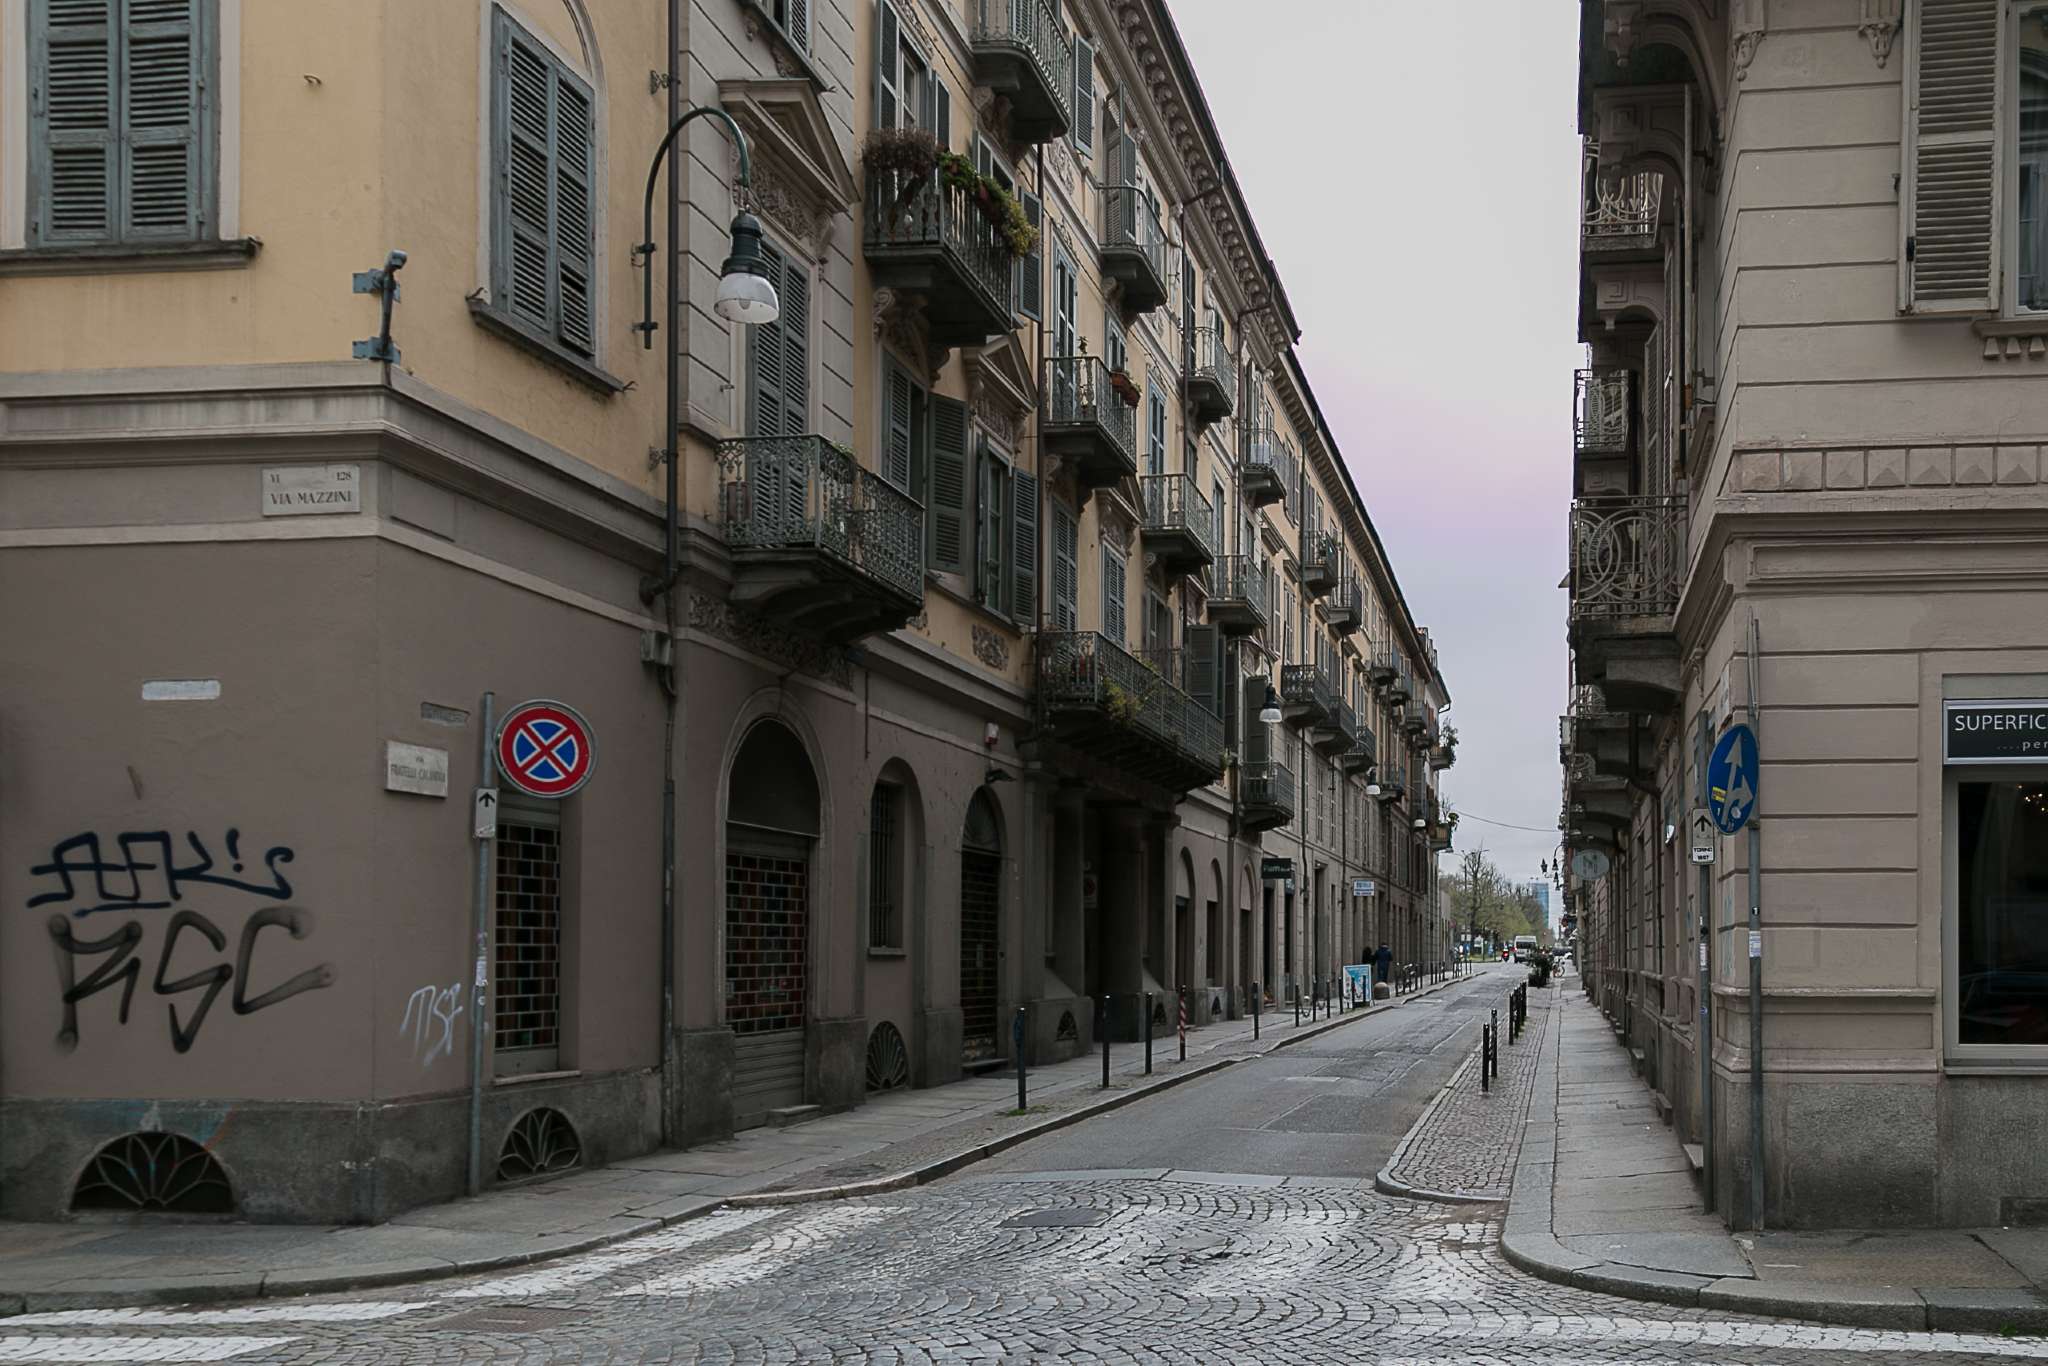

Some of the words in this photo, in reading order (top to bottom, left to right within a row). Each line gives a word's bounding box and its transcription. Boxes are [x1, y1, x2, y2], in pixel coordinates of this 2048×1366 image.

[336, 471, 352, 481] 128
[270, 492, 292, 505] VIA
[297, 490, 351, 504] MAZZINI
[1954, 714, 2048, 731] SUPERFIC
